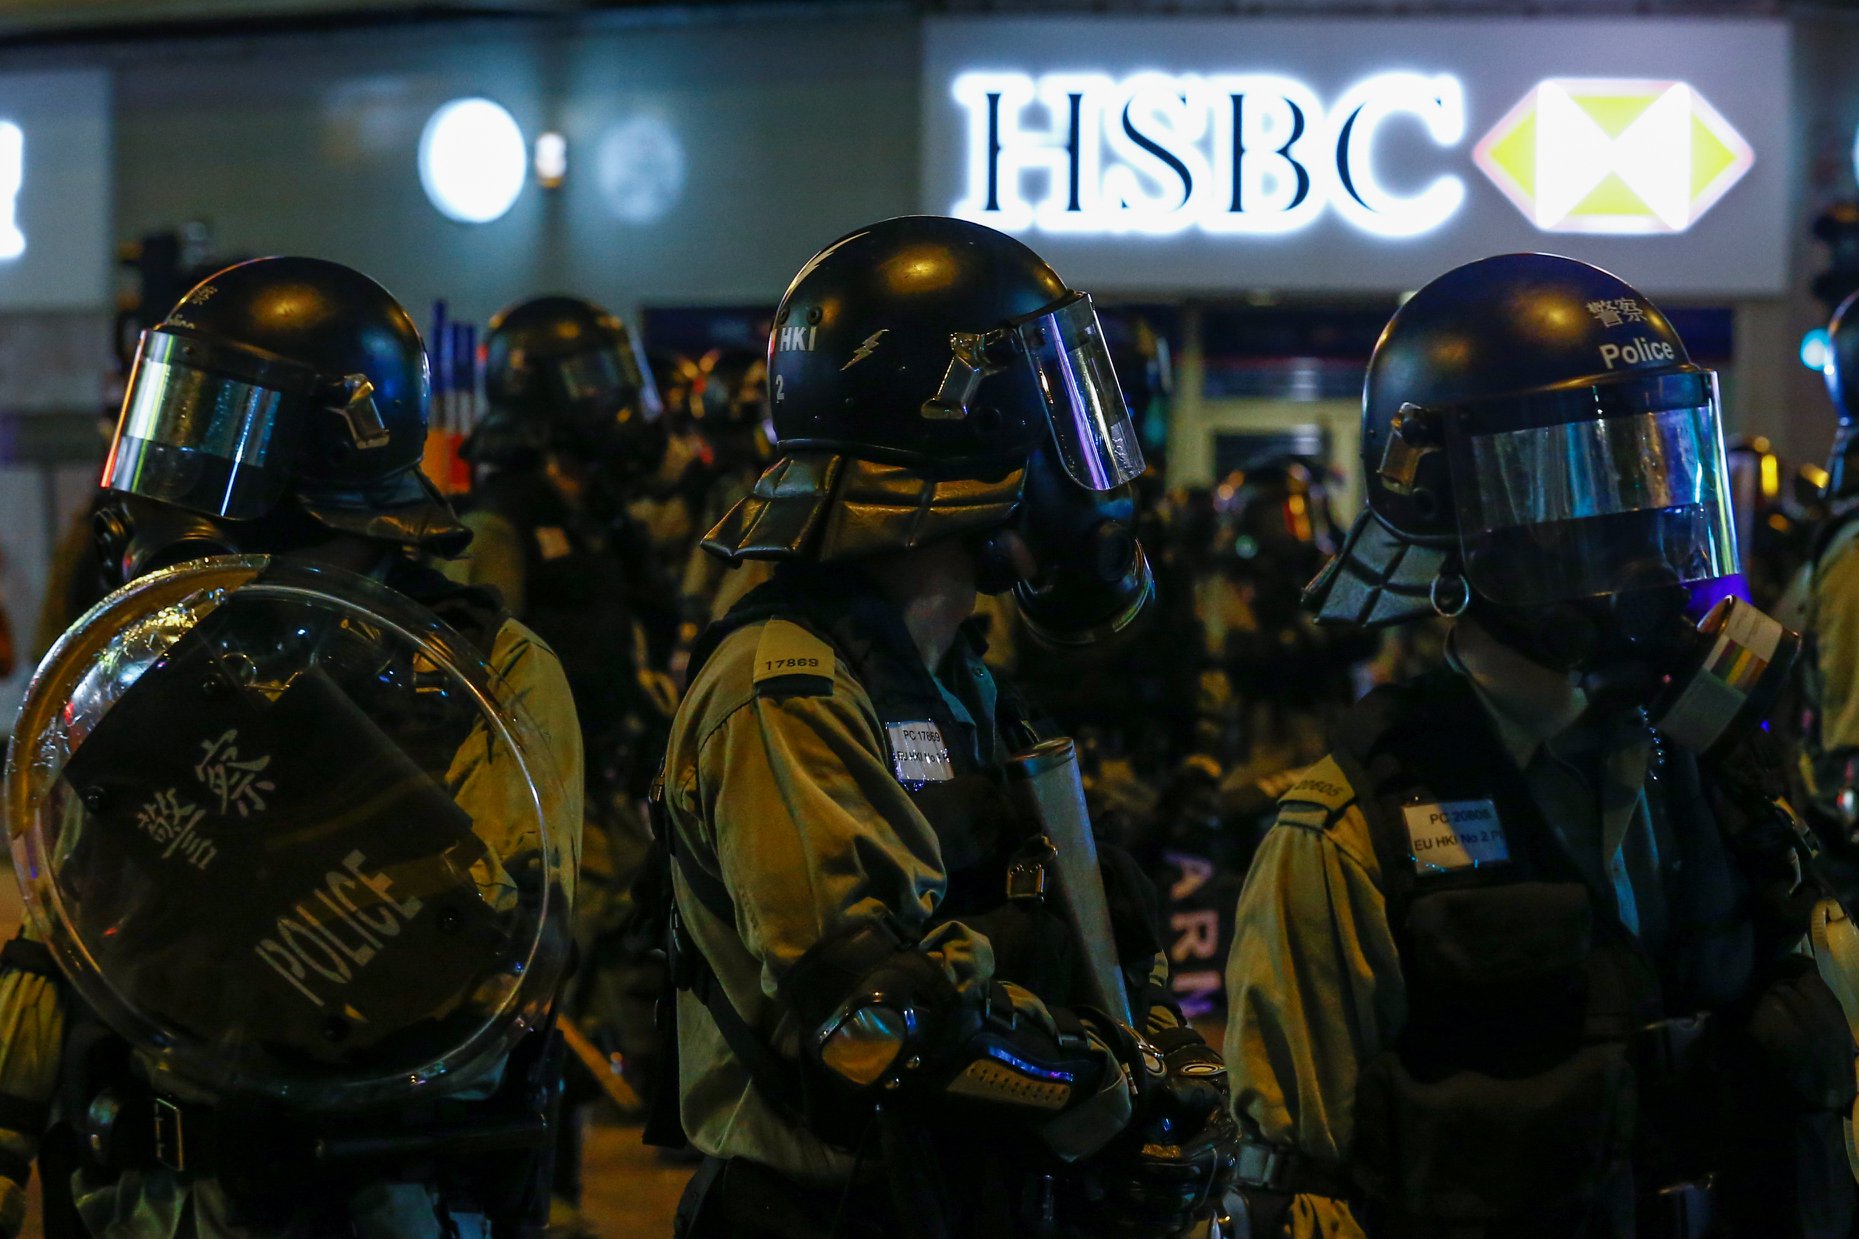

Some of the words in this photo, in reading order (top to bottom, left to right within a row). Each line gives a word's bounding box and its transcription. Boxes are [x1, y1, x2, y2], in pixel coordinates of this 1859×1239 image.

[954, 73, 1464, 236] HSBC
[1586, 297, 1647, 328] 警察
[1599, 337, 1674, 369] Police
[765, 658, 819, 671] 17869
[903, 730, 916, 740] PC
[137, 729, 276, 870] 警察
[1430, 814, 1449, 824] PC
[1414, 839, 1432, 851] EU
[1436, 835, 1457, 848] HKI
[254, 849, 424, 1007] POLICE
